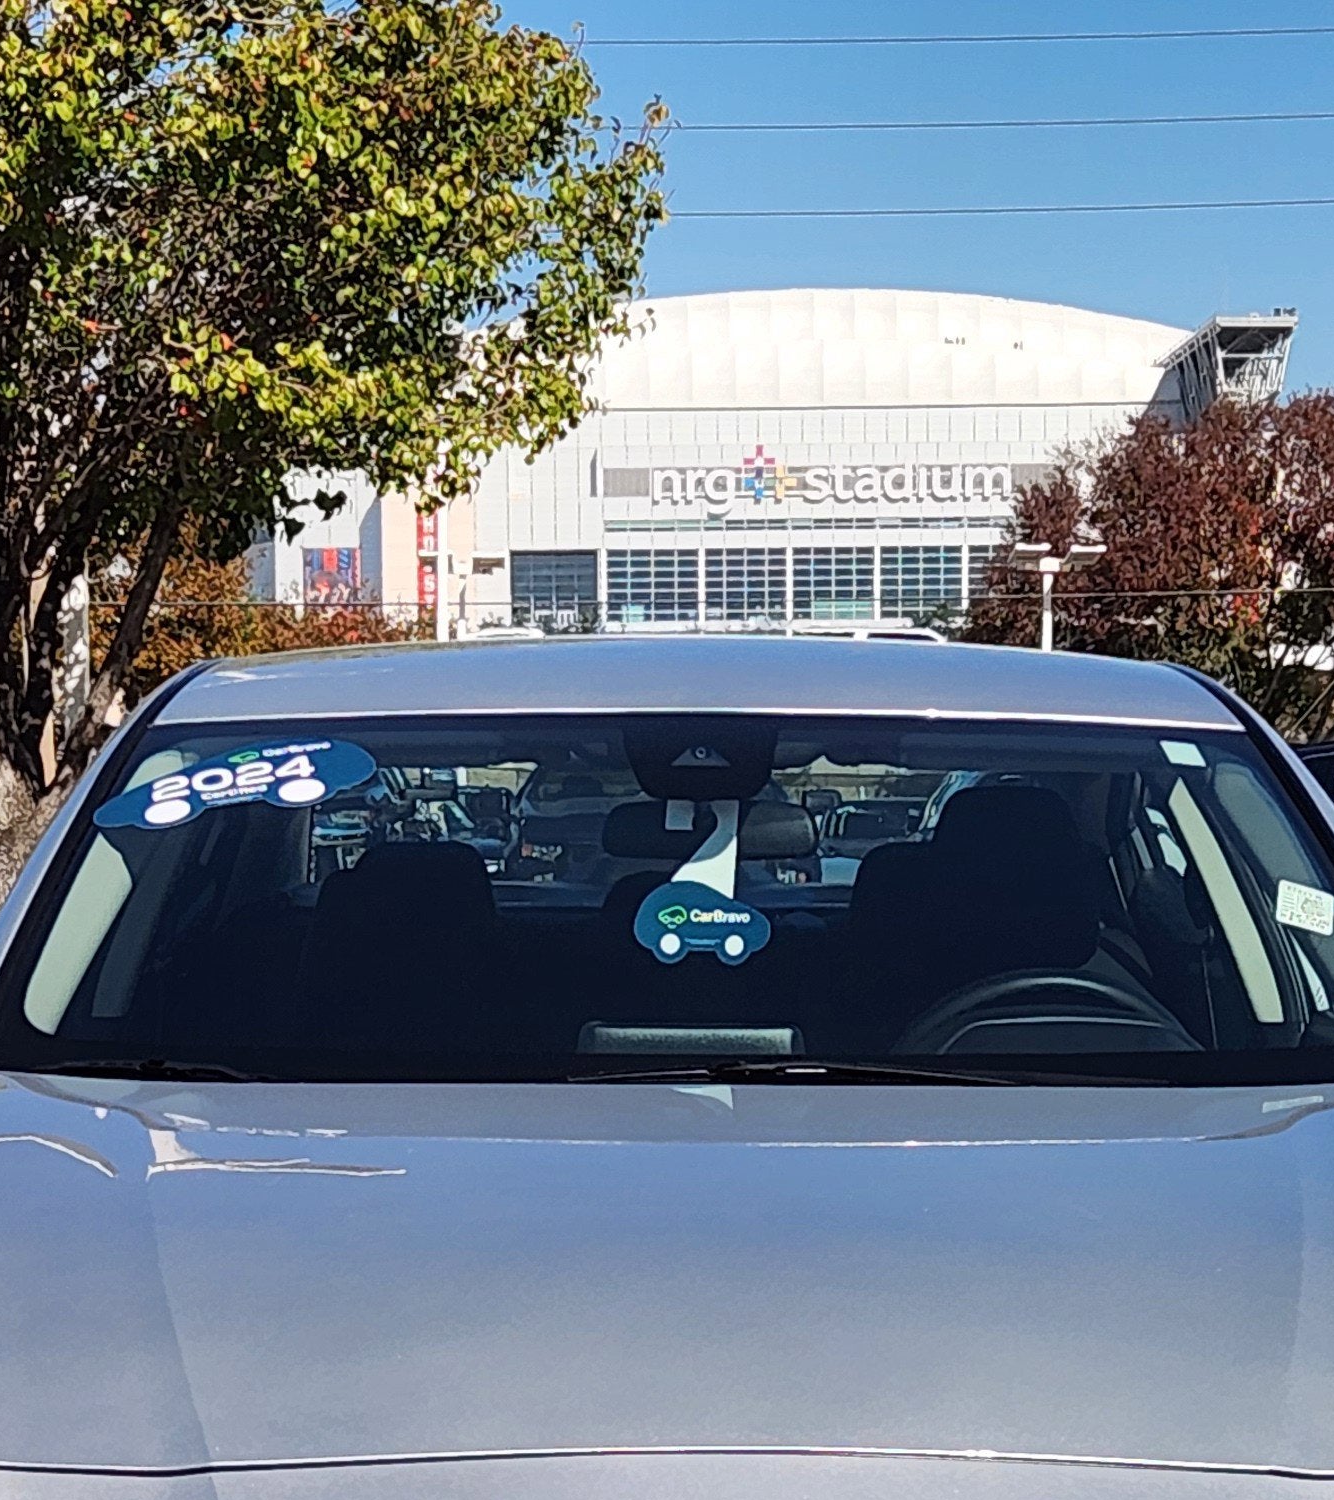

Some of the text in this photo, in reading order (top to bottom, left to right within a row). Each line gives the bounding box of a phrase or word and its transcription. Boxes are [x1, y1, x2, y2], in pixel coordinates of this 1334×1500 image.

[652, 463, 1011, 515] nrg stadium
[151, 755, 316, 803] 2024
[689, 908, 751, 923] CarBravo
